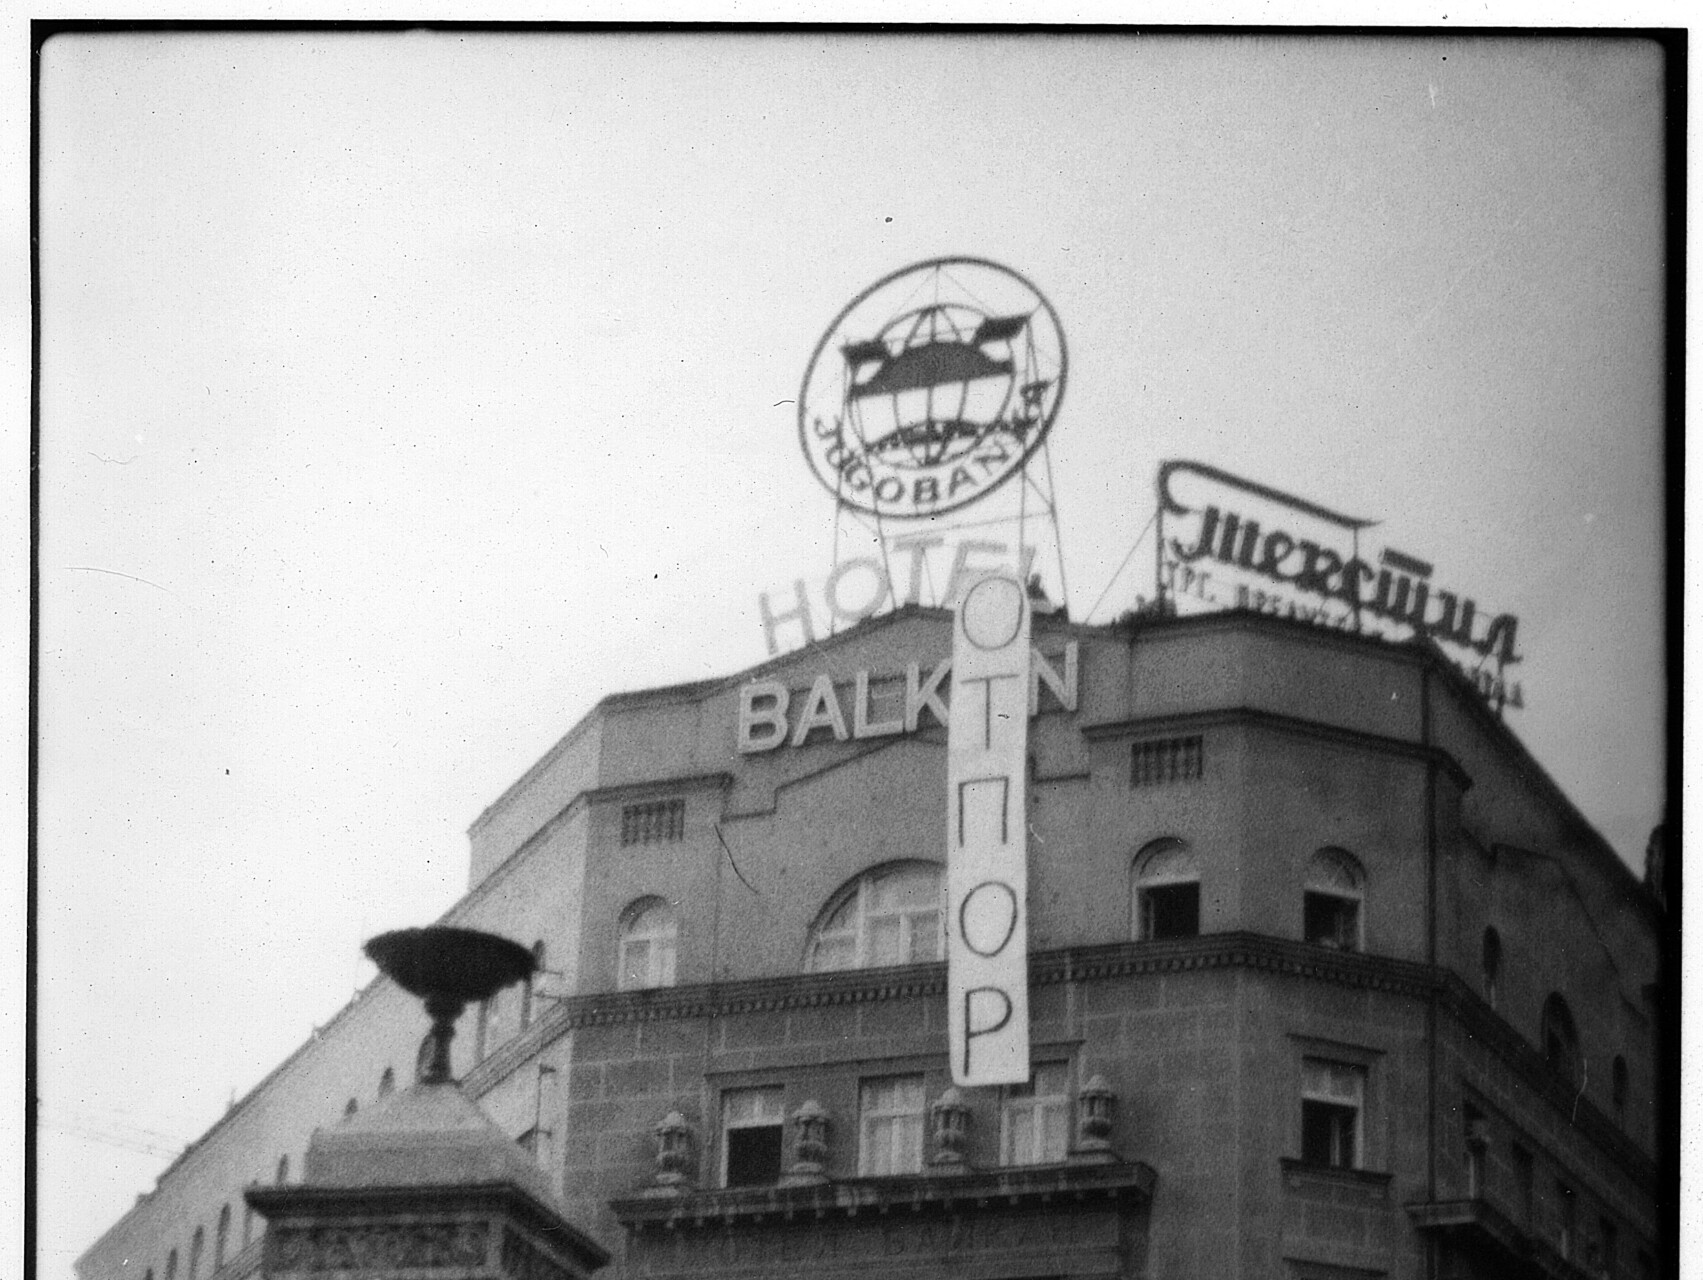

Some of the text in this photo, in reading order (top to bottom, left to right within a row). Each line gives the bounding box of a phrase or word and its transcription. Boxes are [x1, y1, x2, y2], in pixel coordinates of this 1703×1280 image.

[813, 379, 1053, 504] JUGOBANKA
[737, 639, 1079, 752] BALKN
[959, 576, 1024, 1077] ОТПОР
